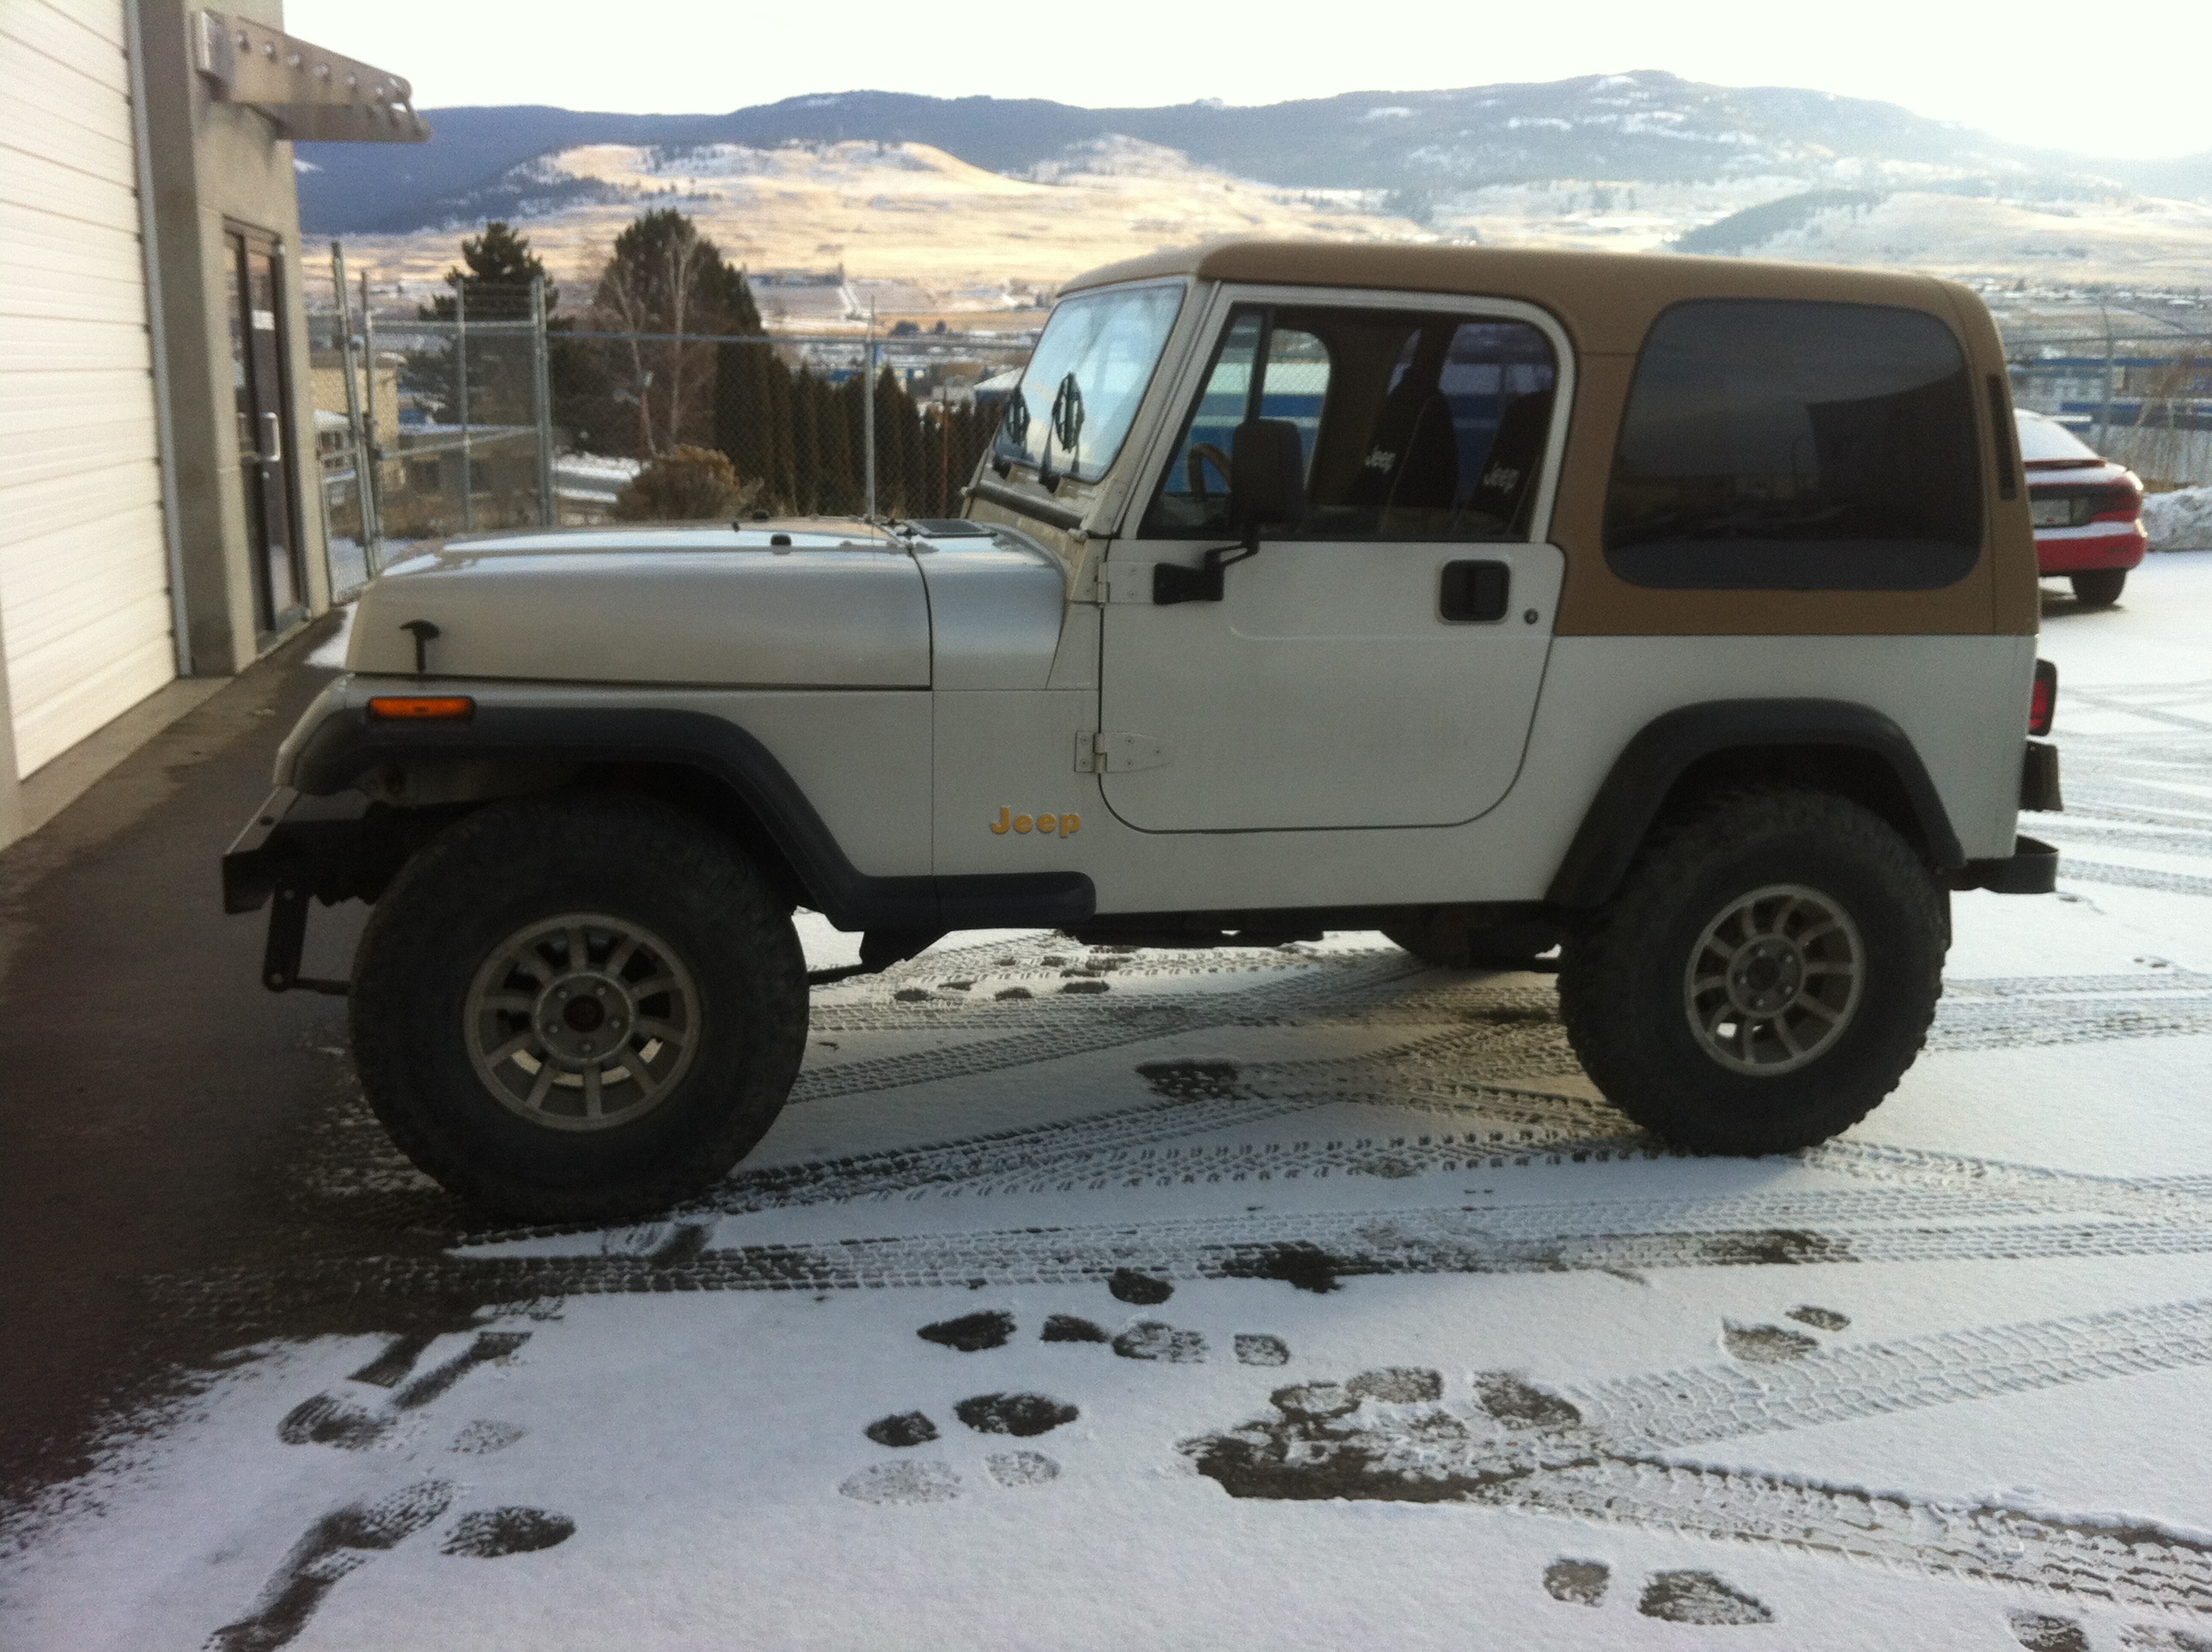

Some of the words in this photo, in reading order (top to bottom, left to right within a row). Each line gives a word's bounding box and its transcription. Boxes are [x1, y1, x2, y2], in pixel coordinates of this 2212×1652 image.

[1365, 445, 1395, 474] Jeep
[1482, 461, 1520, 494] Jeep
[991, 806, 1081, 838] Jeep
